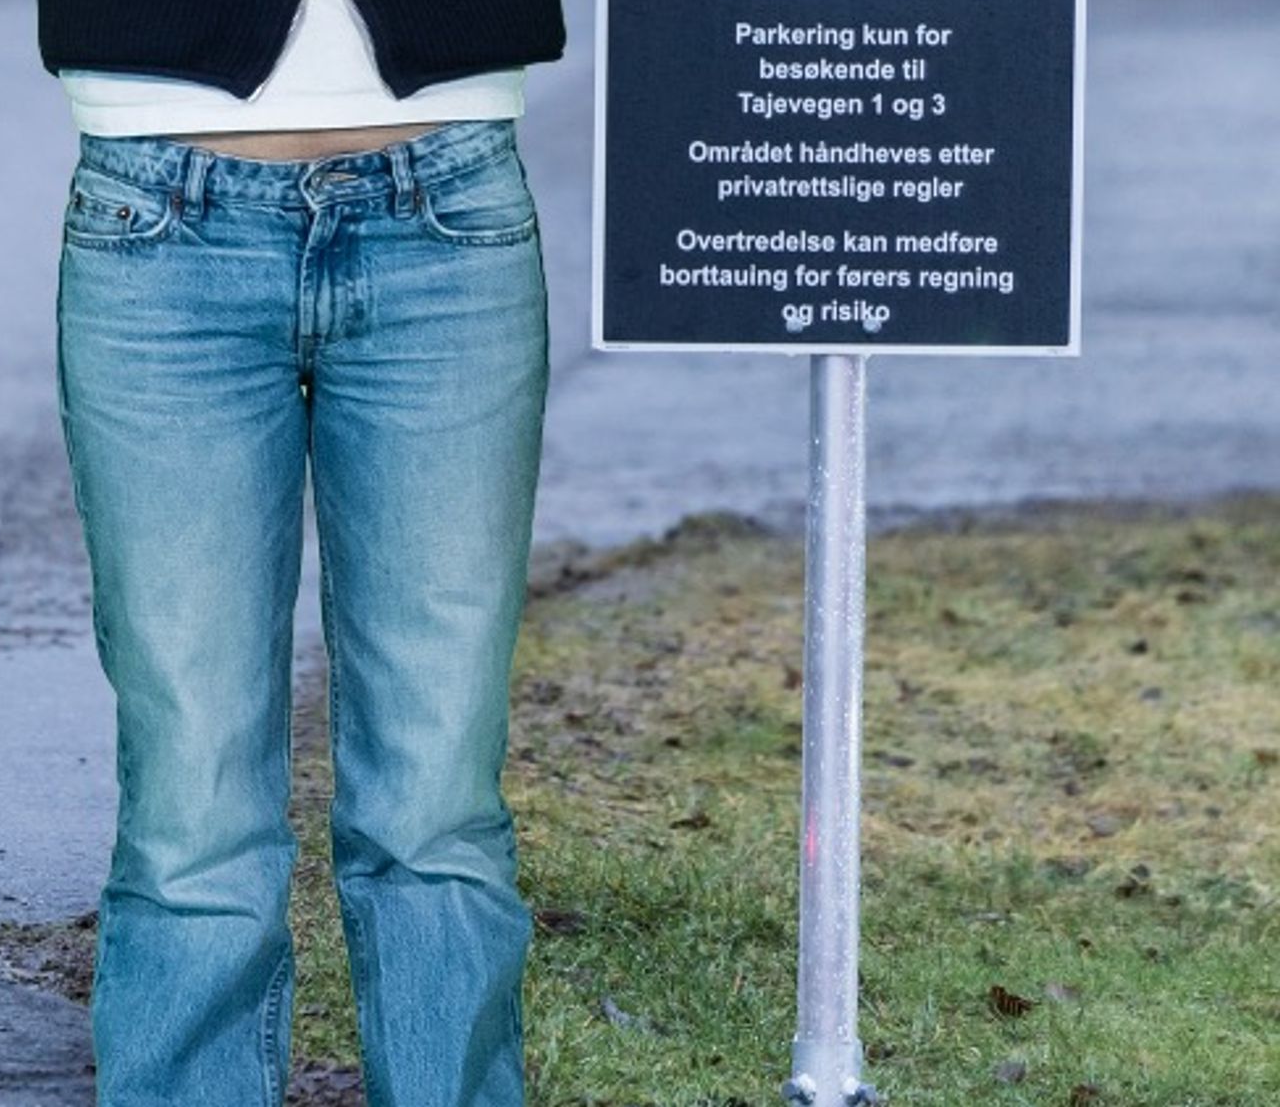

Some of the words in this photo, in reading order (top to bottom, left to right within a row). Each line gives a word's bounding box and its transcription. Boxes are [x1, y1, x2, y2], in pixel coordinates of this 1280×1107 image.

[735, 23, 855, 50] Parkering
[862, 24, 909, 45] kun
[915, 24, 953, 46] for
[759, 58, 895, 80] besøkende
[901, 59, 926, 81] til
[738, 93, 863, 120] Tajevegen
[871, 93, 882, 114] 1
[892, 98, 924, 121] og
[932, 93, 946, 115] 3
[688, 140, 793, 164] Området
[799, 140, 932, 164] håndheves
[938, 143, 996, 165] etter
[718, 174, 885, 202] privatrettslige
[893, 176, 964, 203] regler
[676, 229, 836, 252] Overtredelse
[843, 230, 888, 253] kan
[895, 231, 998, 254] medføre
[660, 263, 788, 292] borttauing
[795, 264, 831, 287] for
[836, 264, 911, 288] førers
[919, 266, 1015, 294] regning
[781, 304, 814, 326] og
[821, 299, 891, 322] risiko
